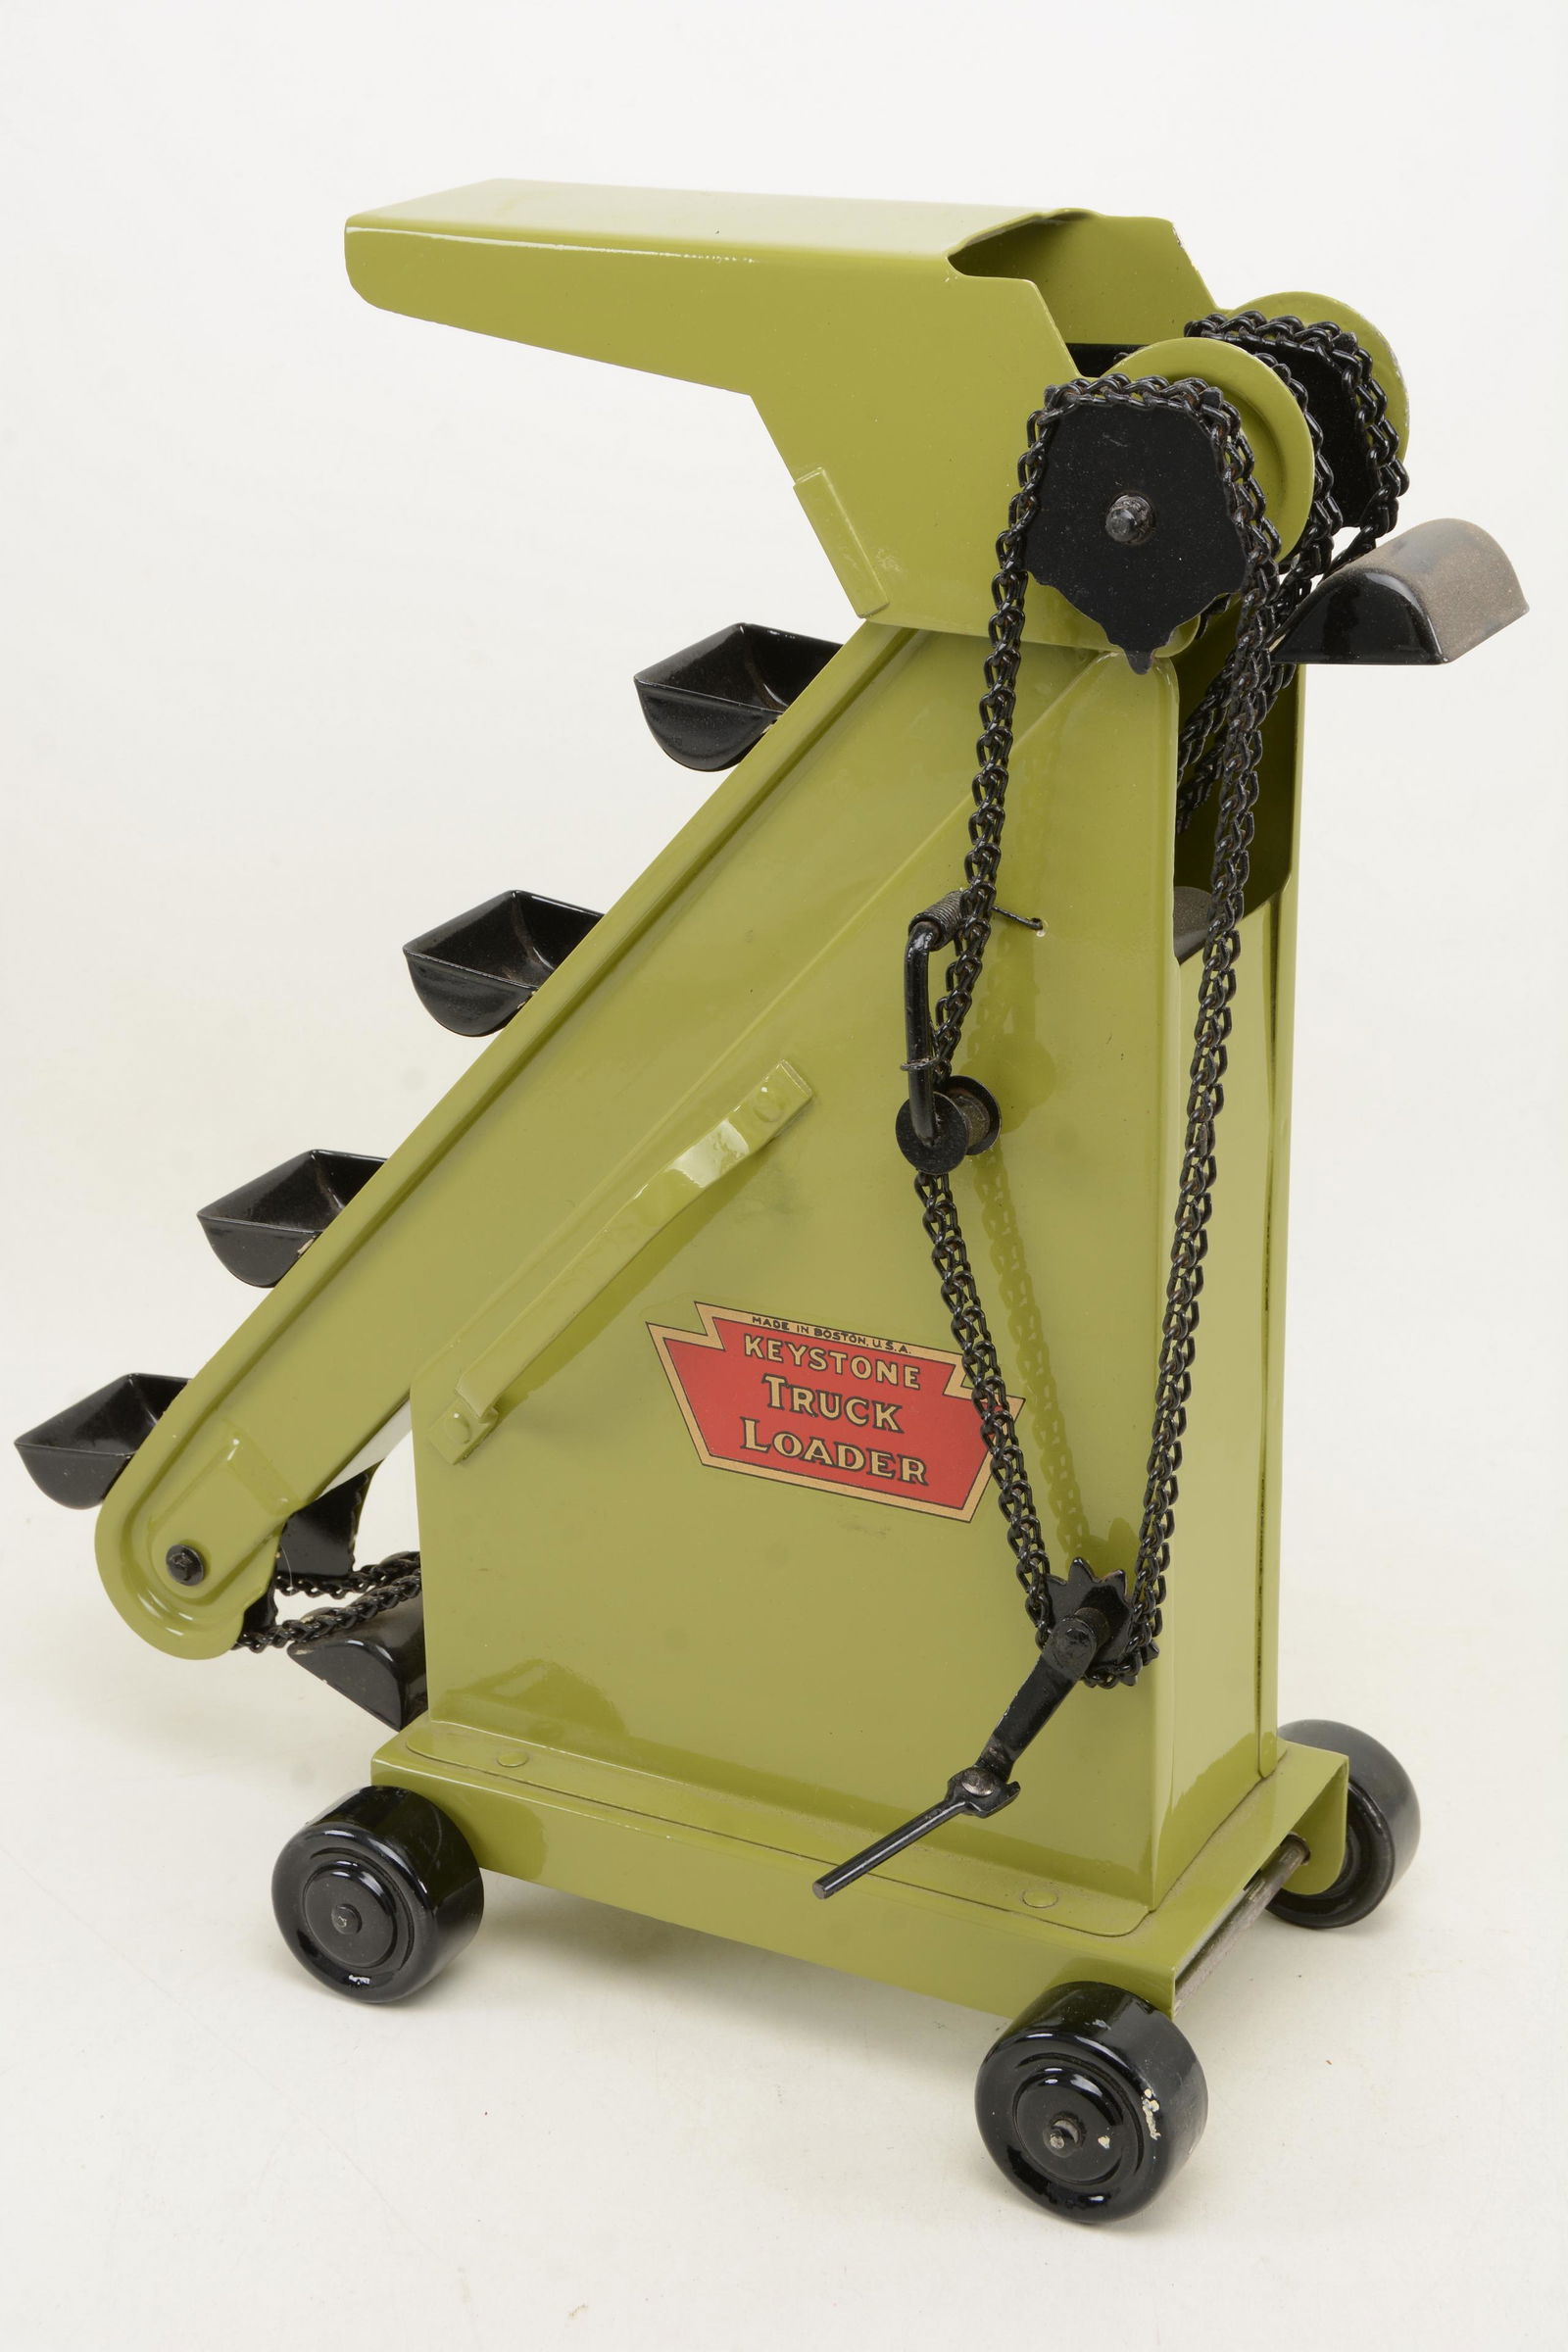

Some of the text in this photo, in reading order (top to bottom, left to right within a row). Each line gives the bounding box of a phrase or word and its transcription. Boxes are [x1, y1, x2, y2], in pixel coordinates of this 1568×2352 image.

[752, 1315, 790, 1331] MADE
[796, 1324, 809, 1335] IN
[744, 1334, 920, 1390] KEYSTONE
[761, 1373, 905, 1434] TRUCK
[740, 1417, 929, 1487] LOADER
